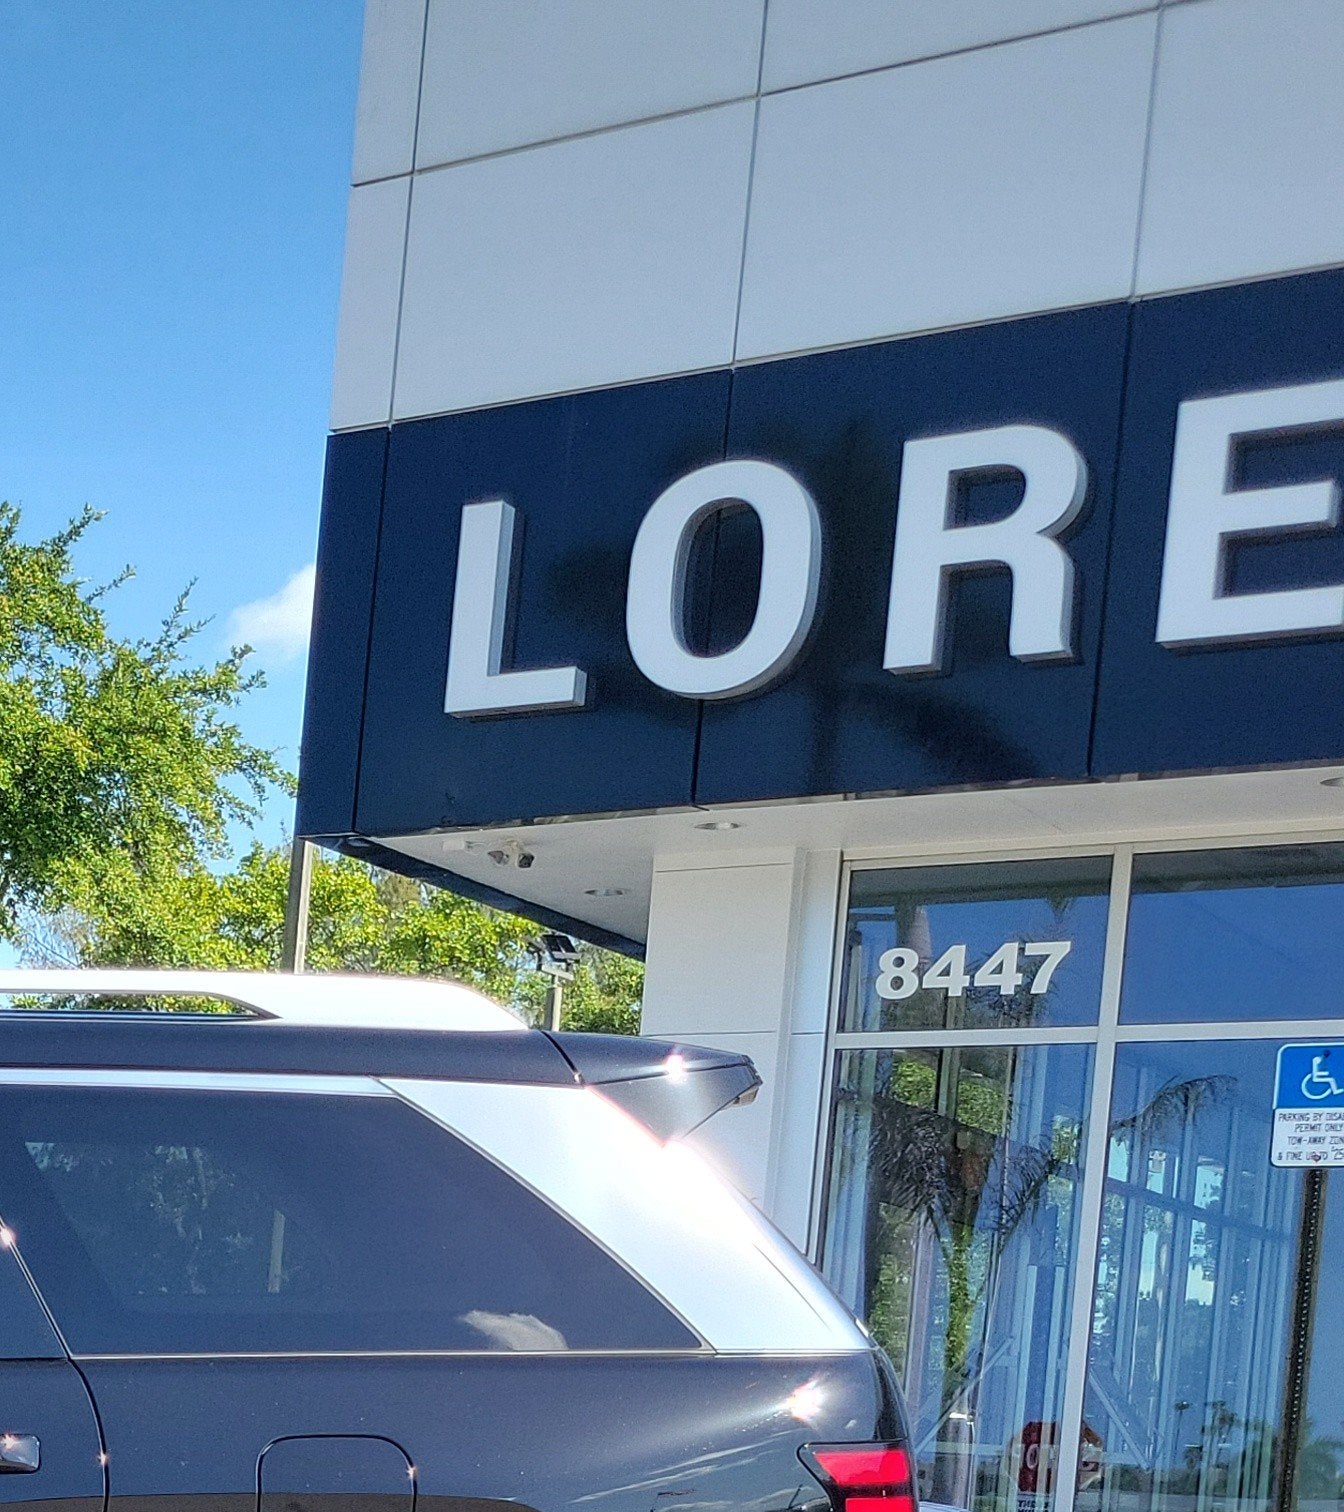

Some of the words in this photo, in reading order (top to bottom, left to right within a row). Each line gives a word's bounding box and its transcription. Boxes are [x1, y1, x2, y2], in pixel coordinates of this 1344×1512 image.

[443, 378, 1344, 718] LORE
[875, 940, 1072, 1000] 8447
[1278, 1112, 1310, 1122] PARKING
[1312, 1112, 1322, 1121] BY
[1294, 1123, 1322, 1132] PERMIT
[1324, 1123, 1343, 1132] ONLY
[1287, 1136, 1326, 1145] TOW-AWAY
[1286, 1151, 1303, 1161] FINE
